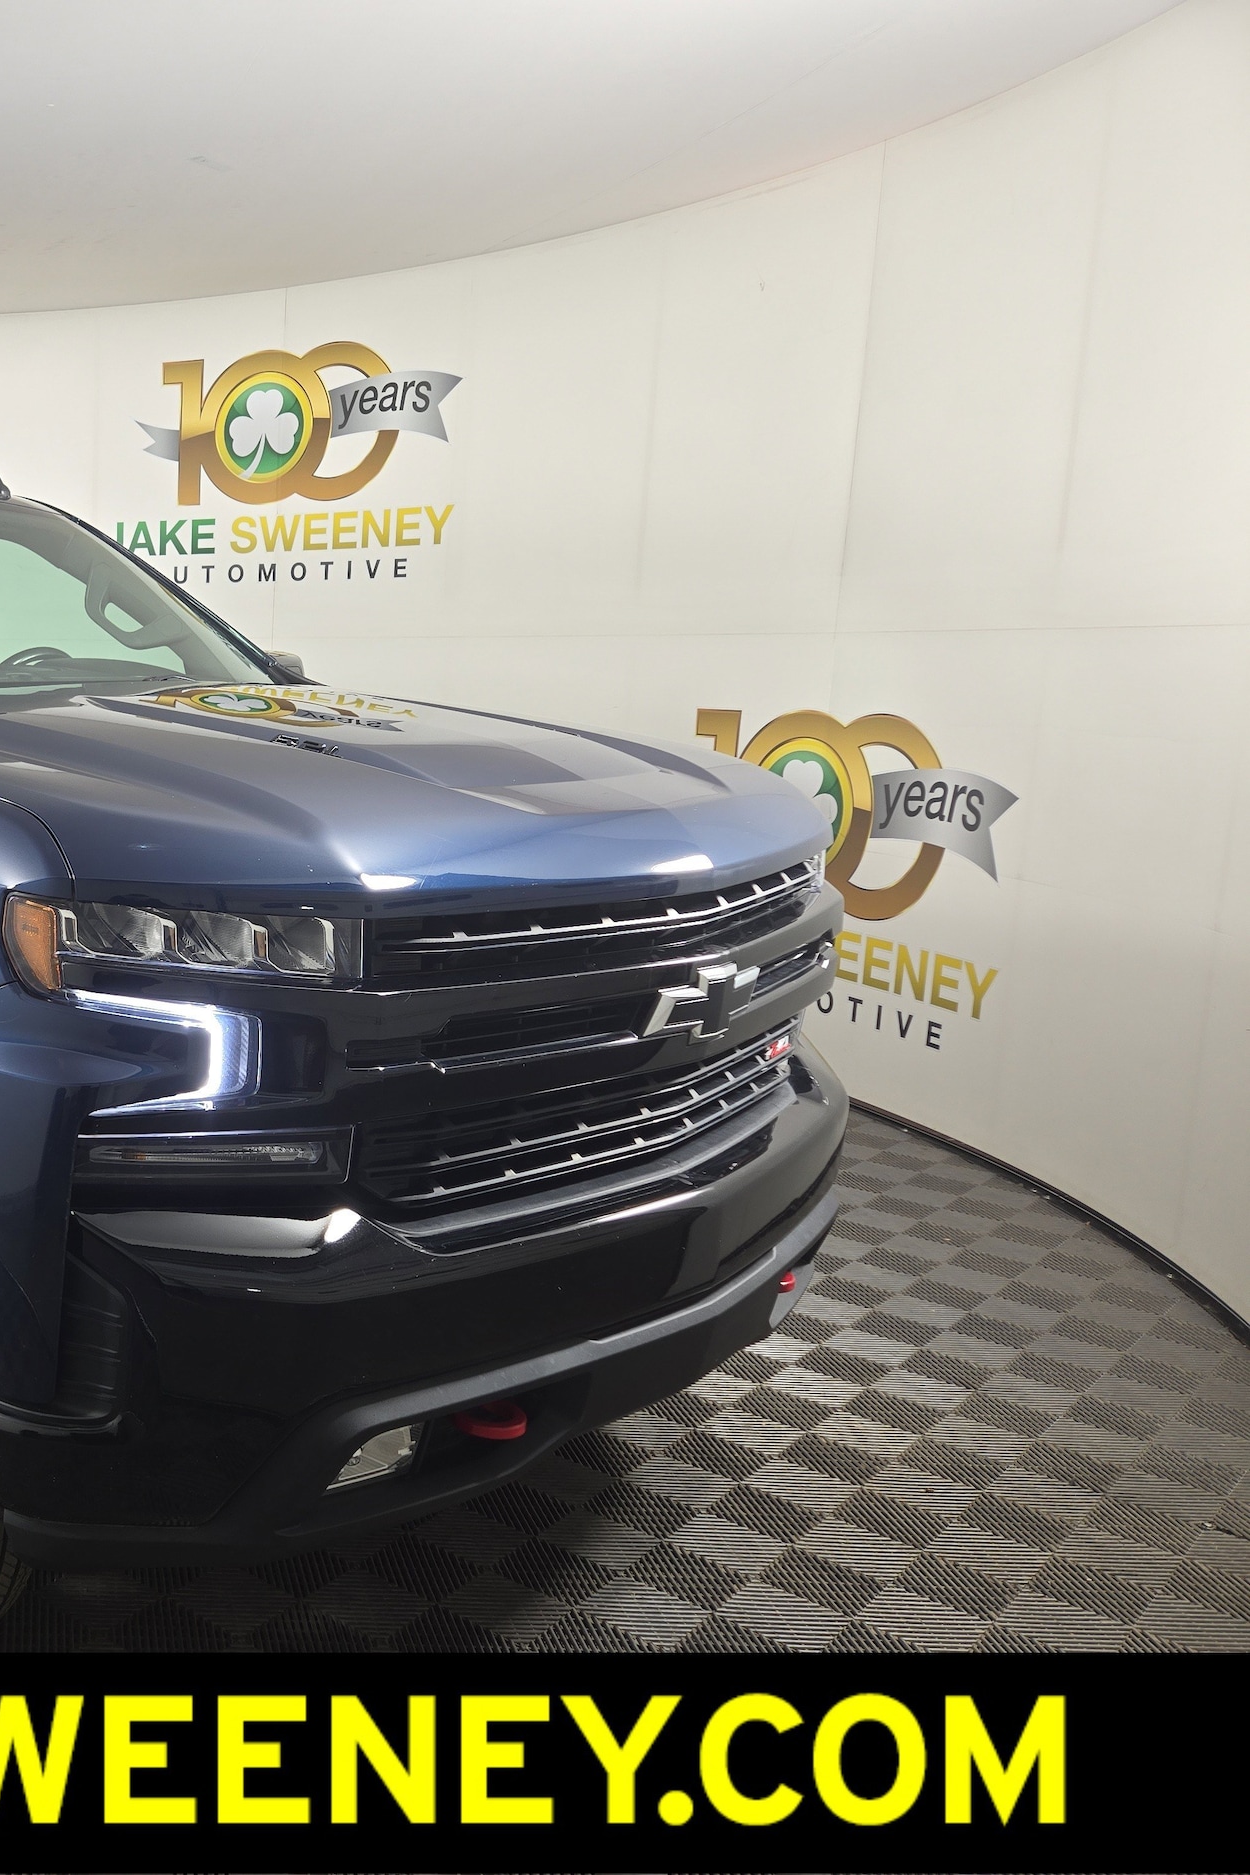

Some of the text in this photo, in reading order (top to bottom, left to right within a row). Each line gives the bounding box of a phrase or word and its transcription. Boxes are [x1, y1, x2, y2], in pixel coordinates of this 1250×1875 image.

[338, 380, 432, 430] years
[230, 504, 454, 555] SWEENEY
[173, 558, 408, 586] UTOMOTIVE
[878, 780, 985, 832] years
[834, 931, 999, 1020] EENEY
[816, 991, 943, 1050] OTIVE
